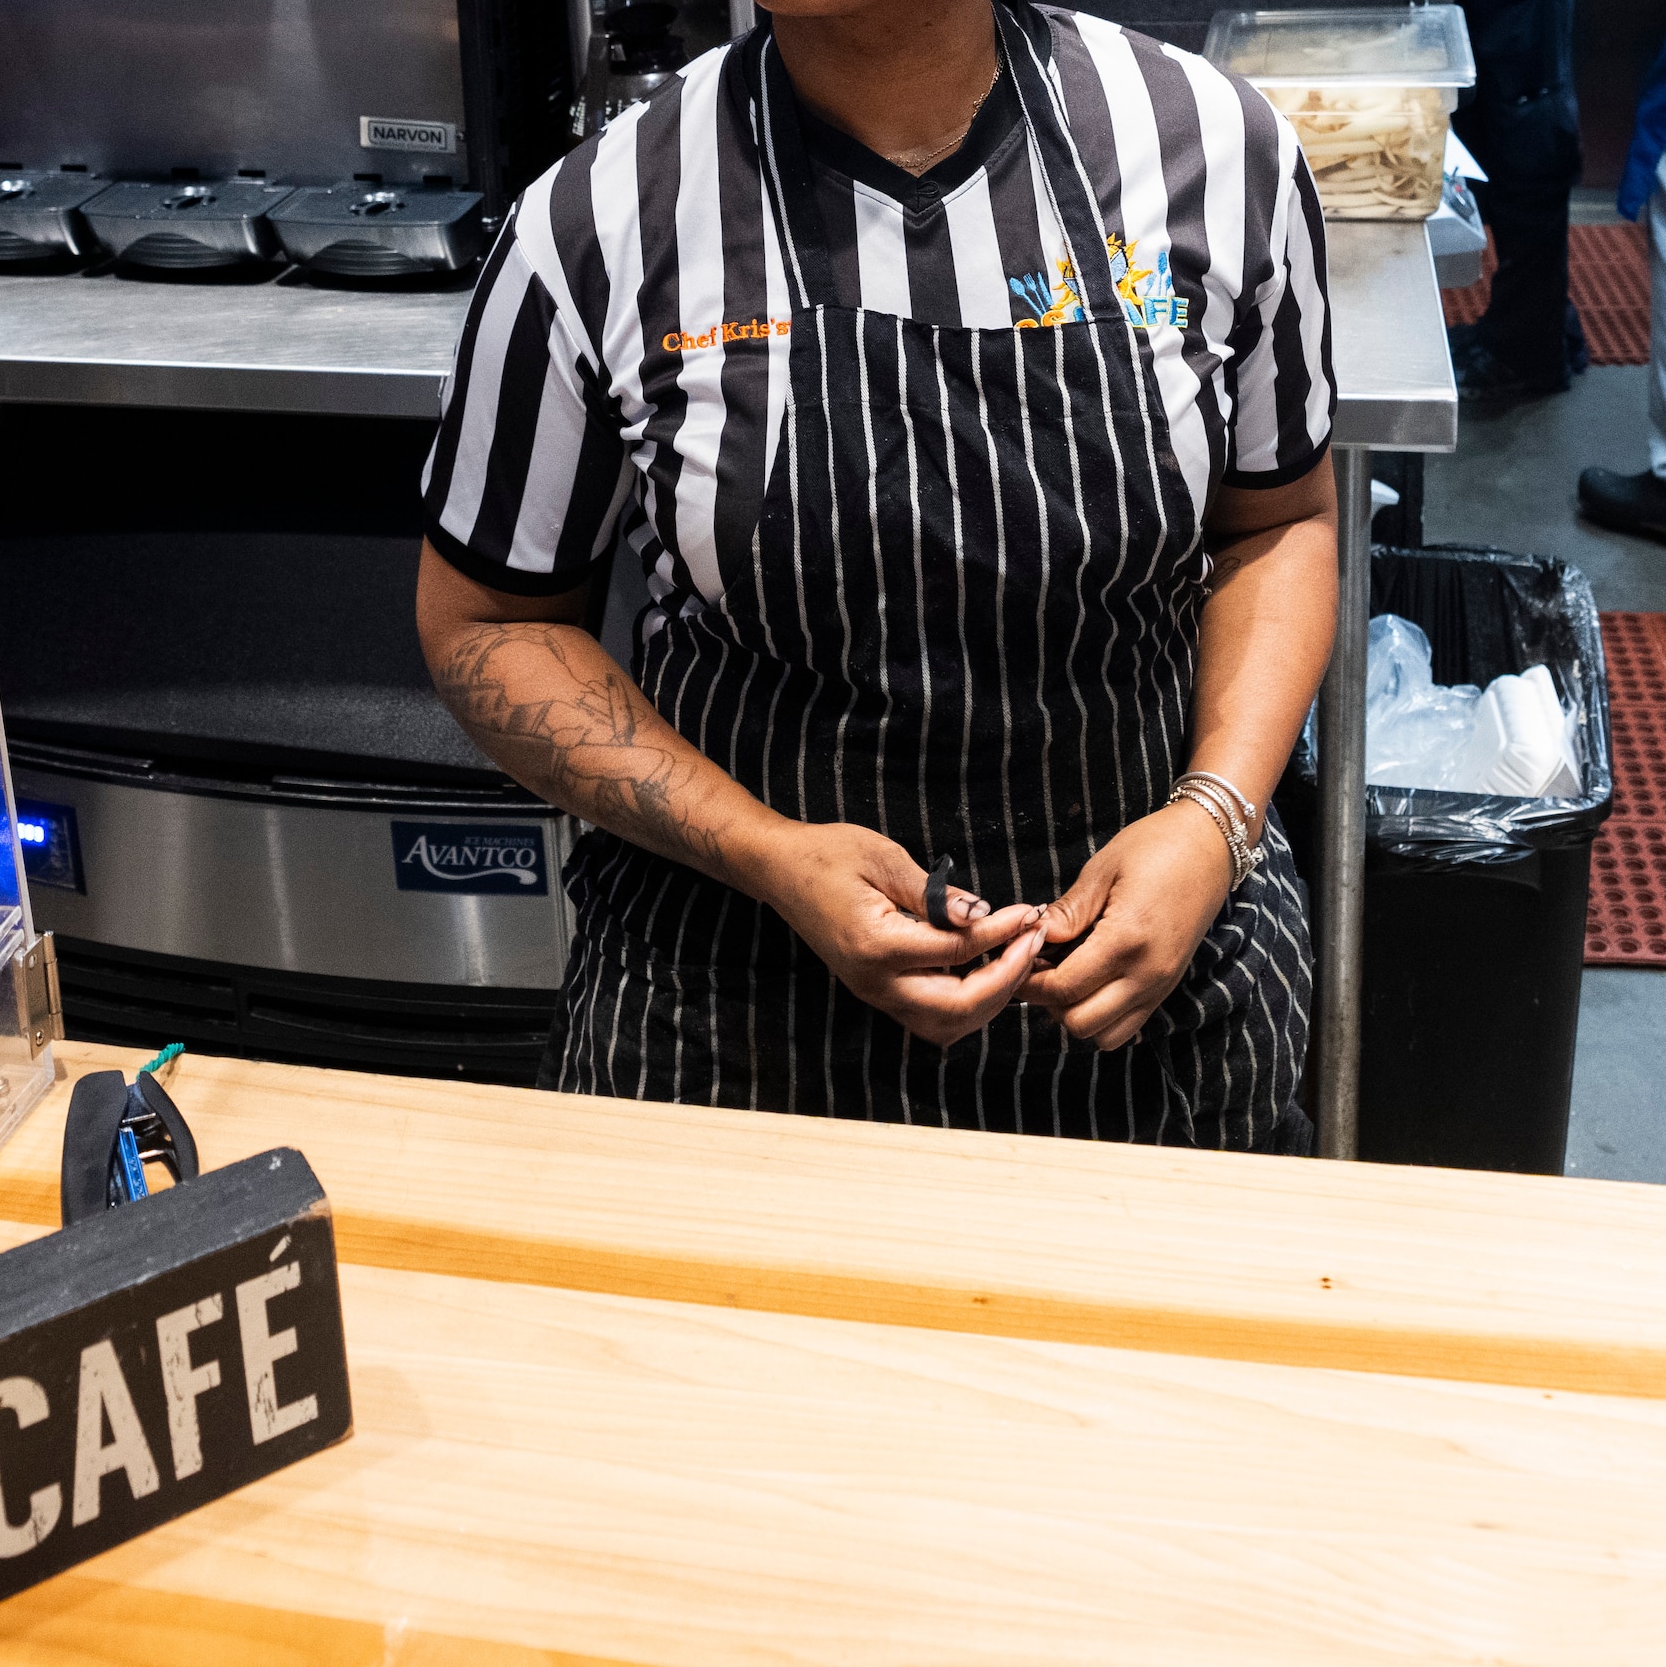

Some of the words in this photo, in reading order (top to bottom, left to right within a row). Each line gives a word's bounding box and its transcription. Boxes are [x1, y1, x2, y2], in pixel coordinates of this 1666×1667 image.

[373, 126, 442, 144] NARVON
[661, 326, 717, 352] Chef
[464, 837, 481, 845] ICE
[483, 837, 535, 847] MACHINES
[402, 835, 537, 879] AVANTCO
